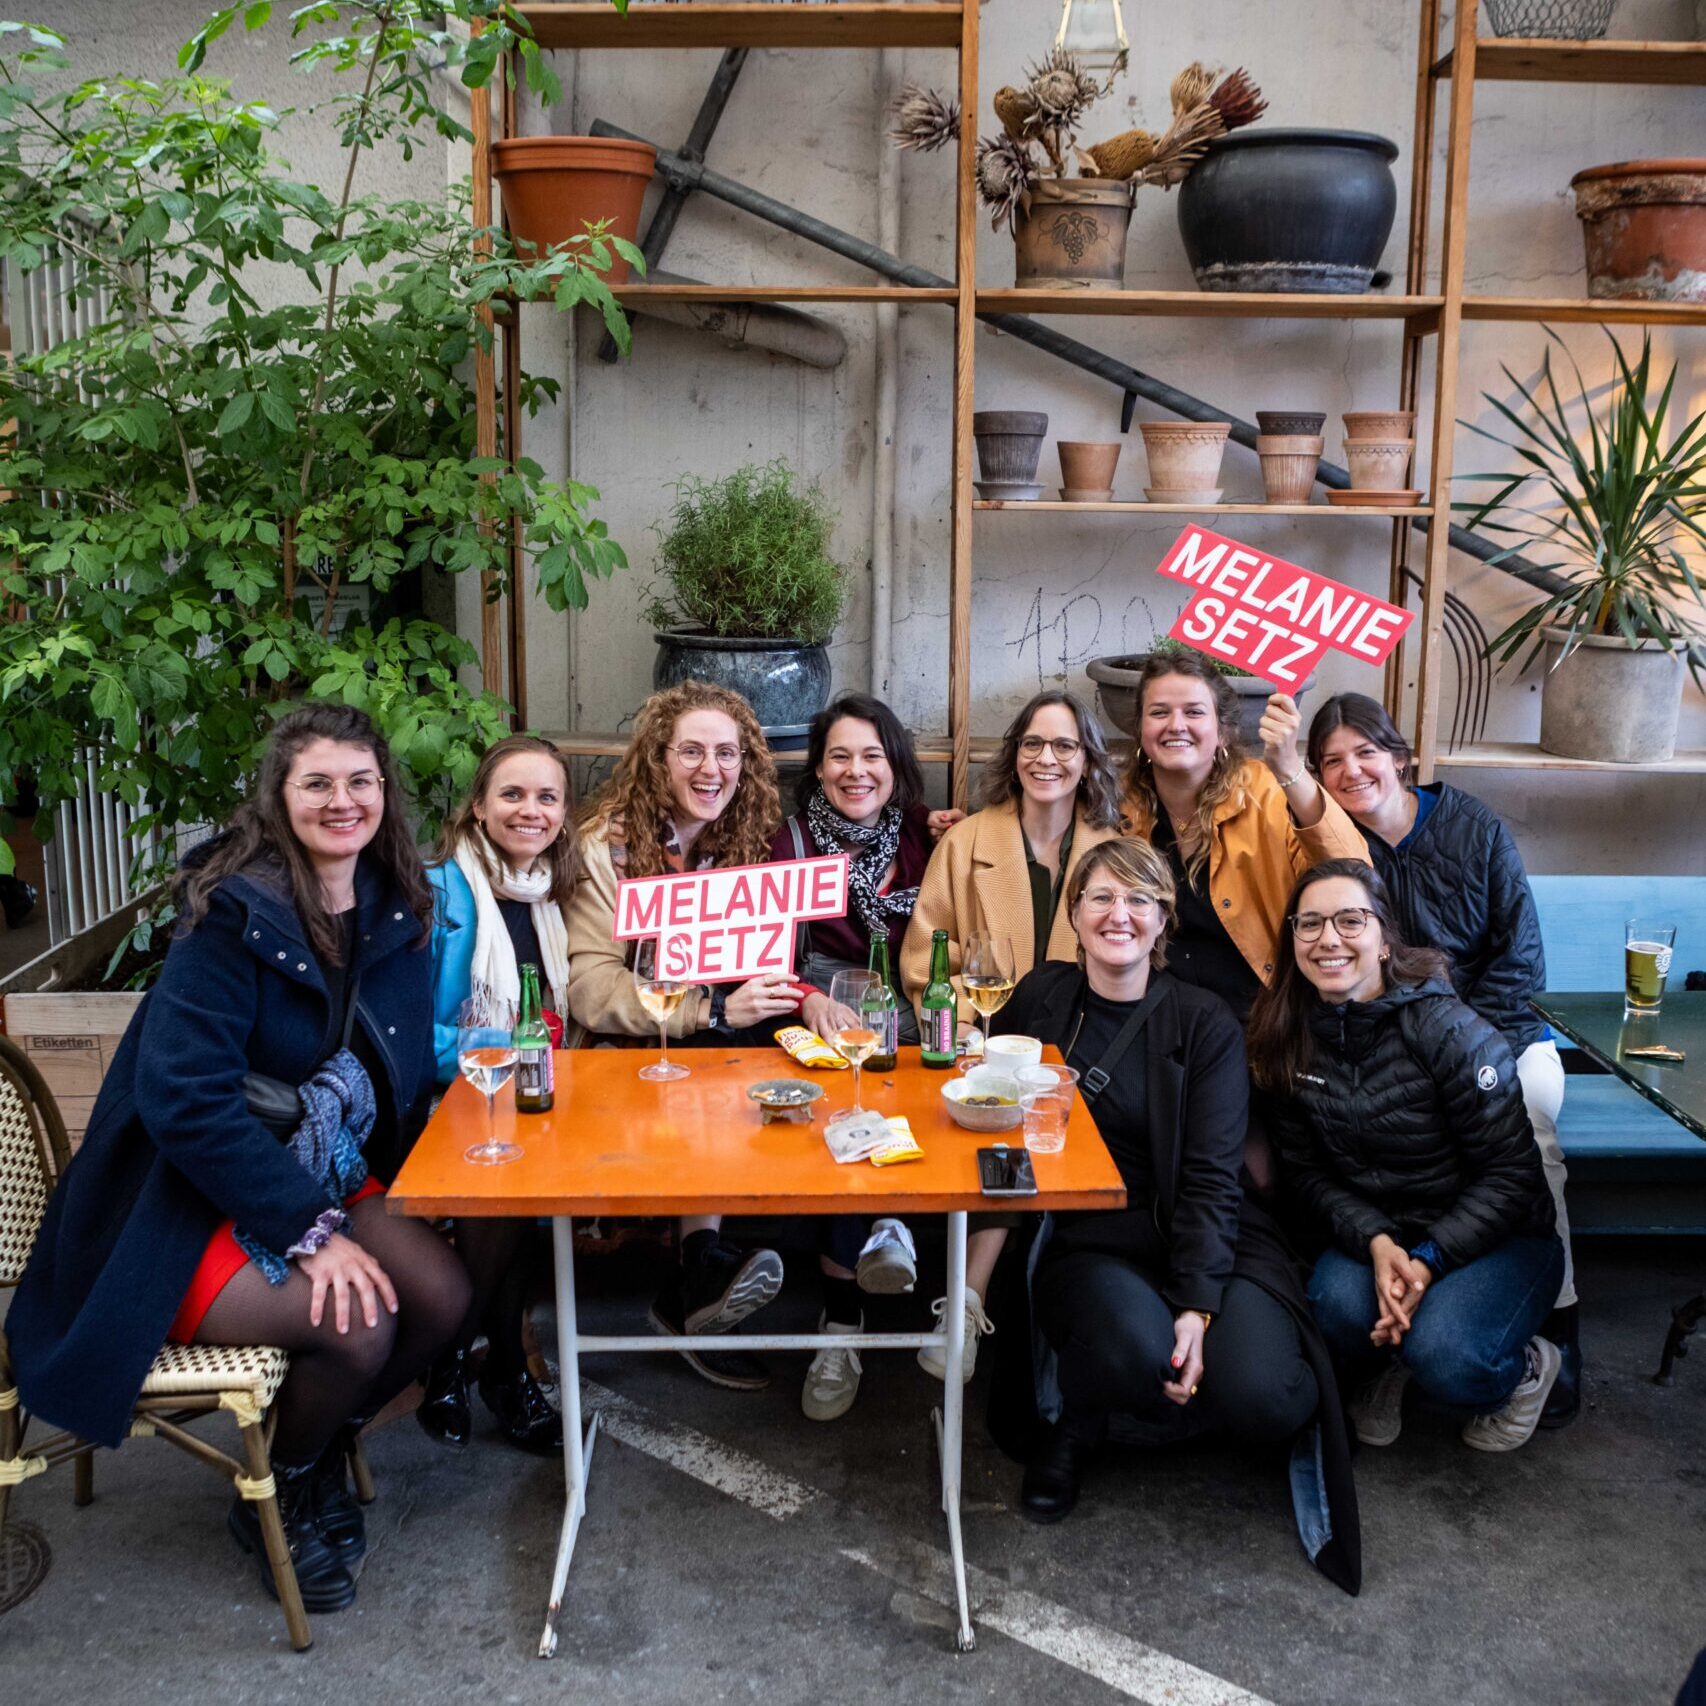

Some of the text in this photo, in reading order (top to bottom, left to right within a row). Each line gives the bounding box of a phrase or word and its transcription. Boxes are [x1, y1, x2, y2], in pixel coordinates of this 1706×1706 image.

[1168, 532, 1404, 658] MELANIE
[1182, 597, 1319, 682] SETZ
[625, 864, 838, 931] MELANIE
[665, 922, 784, 977] SETZ
[33, 1036, 93, 1048] Etiketten
